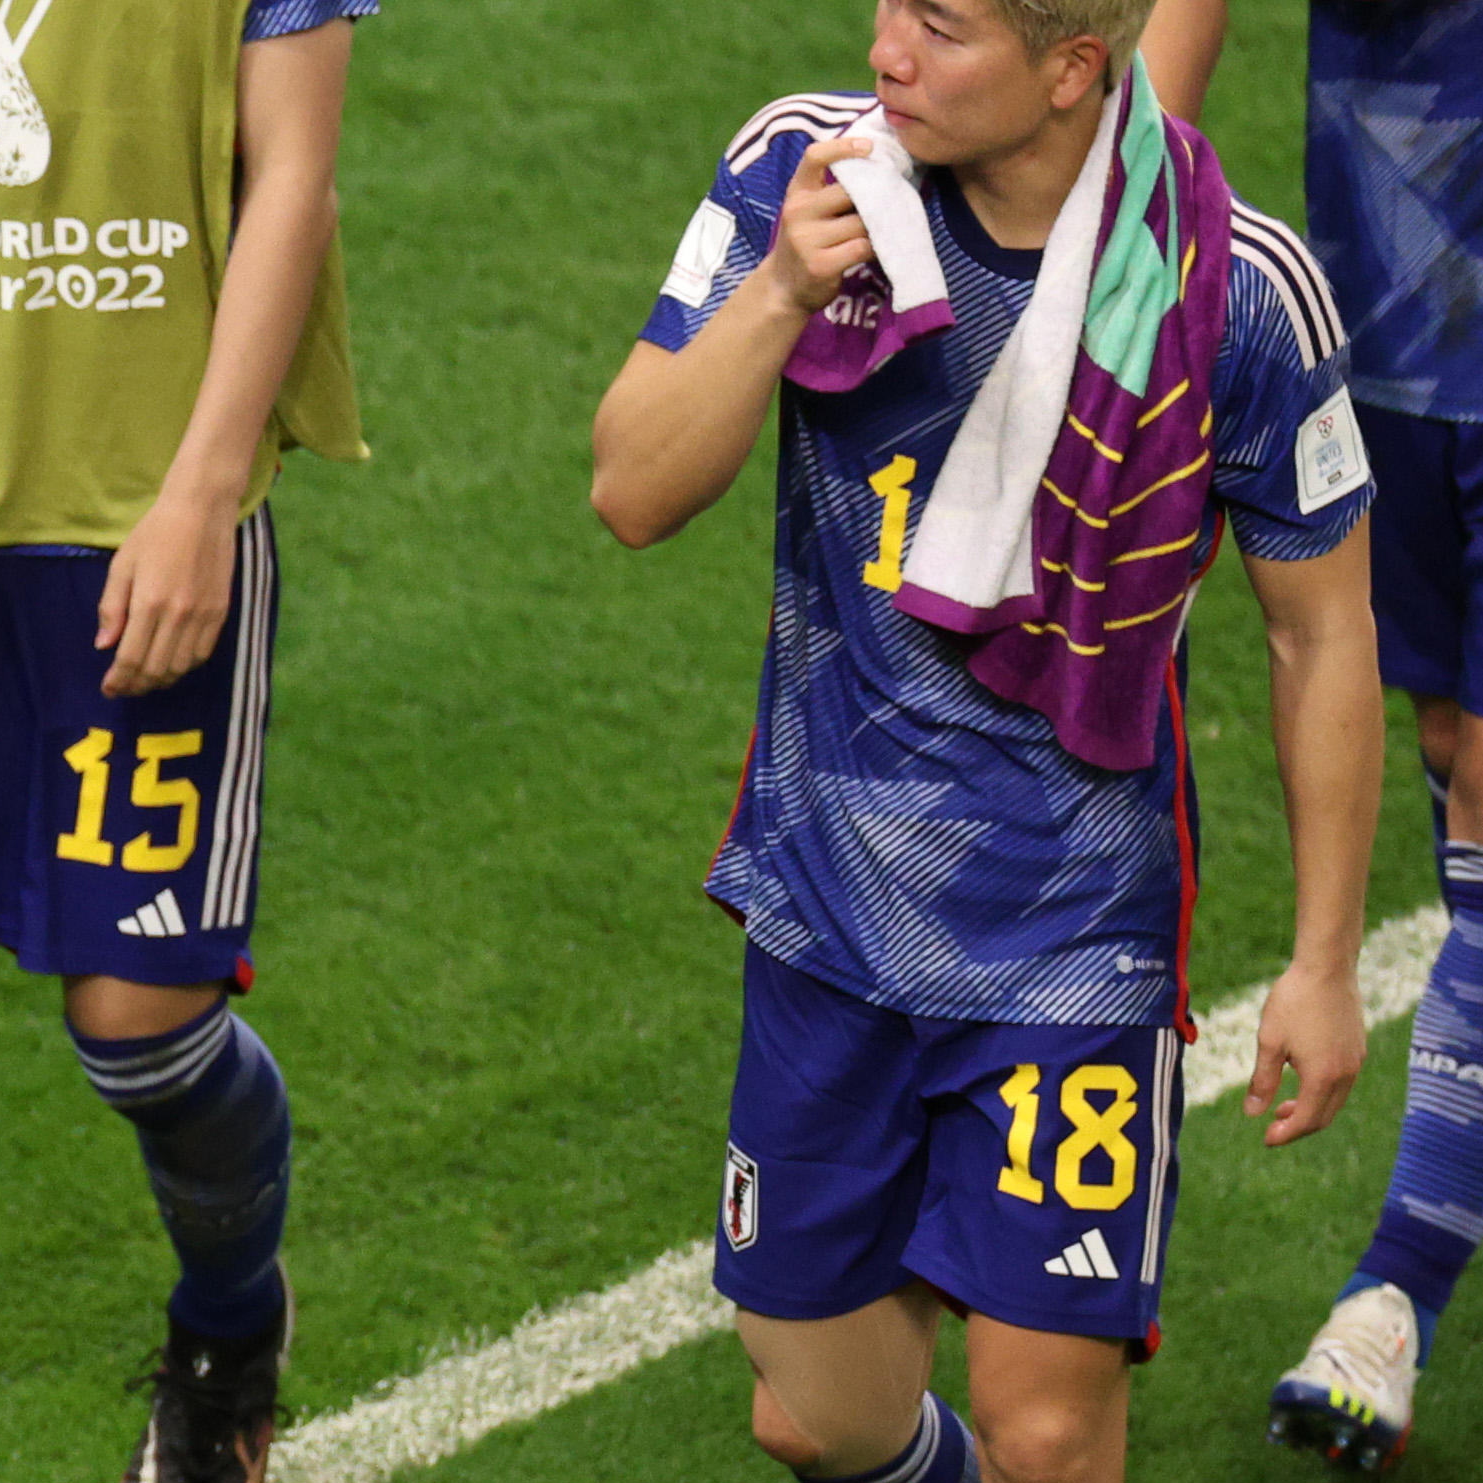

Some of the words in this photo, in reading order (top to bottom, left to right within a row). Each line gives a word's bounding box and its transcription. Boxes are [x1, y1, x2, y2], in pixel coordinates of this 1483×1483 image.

[95, 218, 190, 260] CUP
[862, 453, 917, 593] 1
[55, 727, 203, 873] 15
[997, 1063, 1138, 1212] 18
